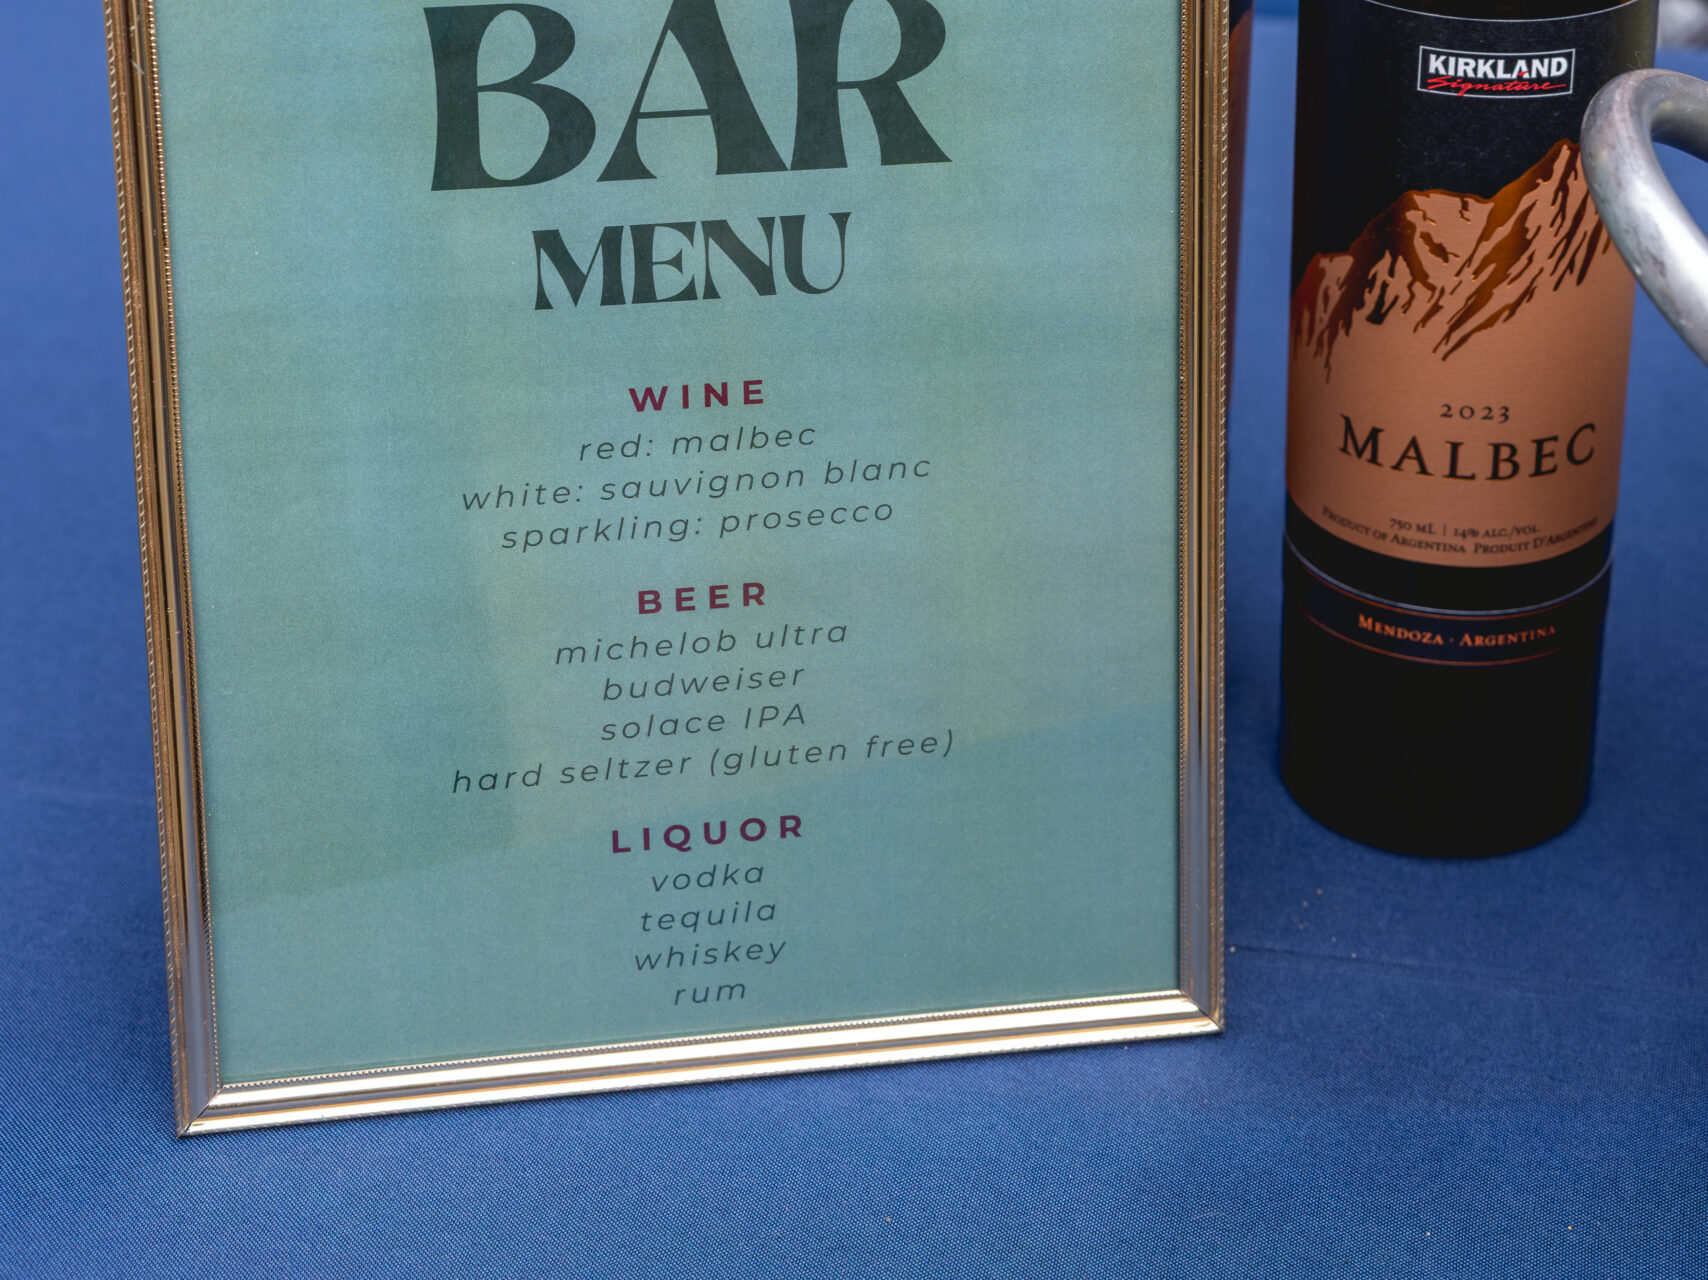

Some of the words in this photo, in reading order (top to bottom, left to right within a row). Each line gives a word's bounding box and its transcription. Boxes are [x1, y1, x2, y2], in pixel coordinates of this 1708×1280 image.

[1428, 53, 1568, 80] KIRKLAND
[1427, 75, 1567, 97] Signature
[532, 212, 852, 310] MENU
[629, 380, 763, 412] WINE
[1440, 403, 1510, 424] 2023
[580, 434, 652, 461] red:
[673, 426, 815, 454] malbec
[1338, 413, 1597, 481] MALBEC
[463, 483, 582, 510] white:
[601, 470, 803, 500] sauvignon
[825, 459, 930, 484] blanc
[502, 516, 701, 553] sparkling:
[720, 504, 892, 538] prosecco
[1372, 528, 1388, 541] OF
[1389, 532, 1468, 554] ARGENTINA
[1473, 539, 1531, 555] PRODUIT
[1389, 517, 1413, 531] 750
[1453, 527, 1480, 539] 14%
[638, 582, 764, 614] BEER
[556, 629, 736, 664] michelob
[756, 624, 847, 648] ultra
[1357, 612, 1445, 646] MENDOZA
[1458, 624, 1557, 648] ARGENTINA
[603, 668, 804, 701] budweiser
[601, 714, 725, 740] solace
[745, 703, 805, 729] IPA
[453, 763, 542, 793] hard
[560, 757, 691, 784] seltzer
[711, 744, 846, 776] (gluten
[867, 729, 952, 758] free)
[612, 815, 801, 853] LIQUOR
[652, 864, 763, 892] vodka
[641, 901, 775, 933] tequila
[635, 941, 786, 970] whiskey
[674, 983, 745, 1005] rum
